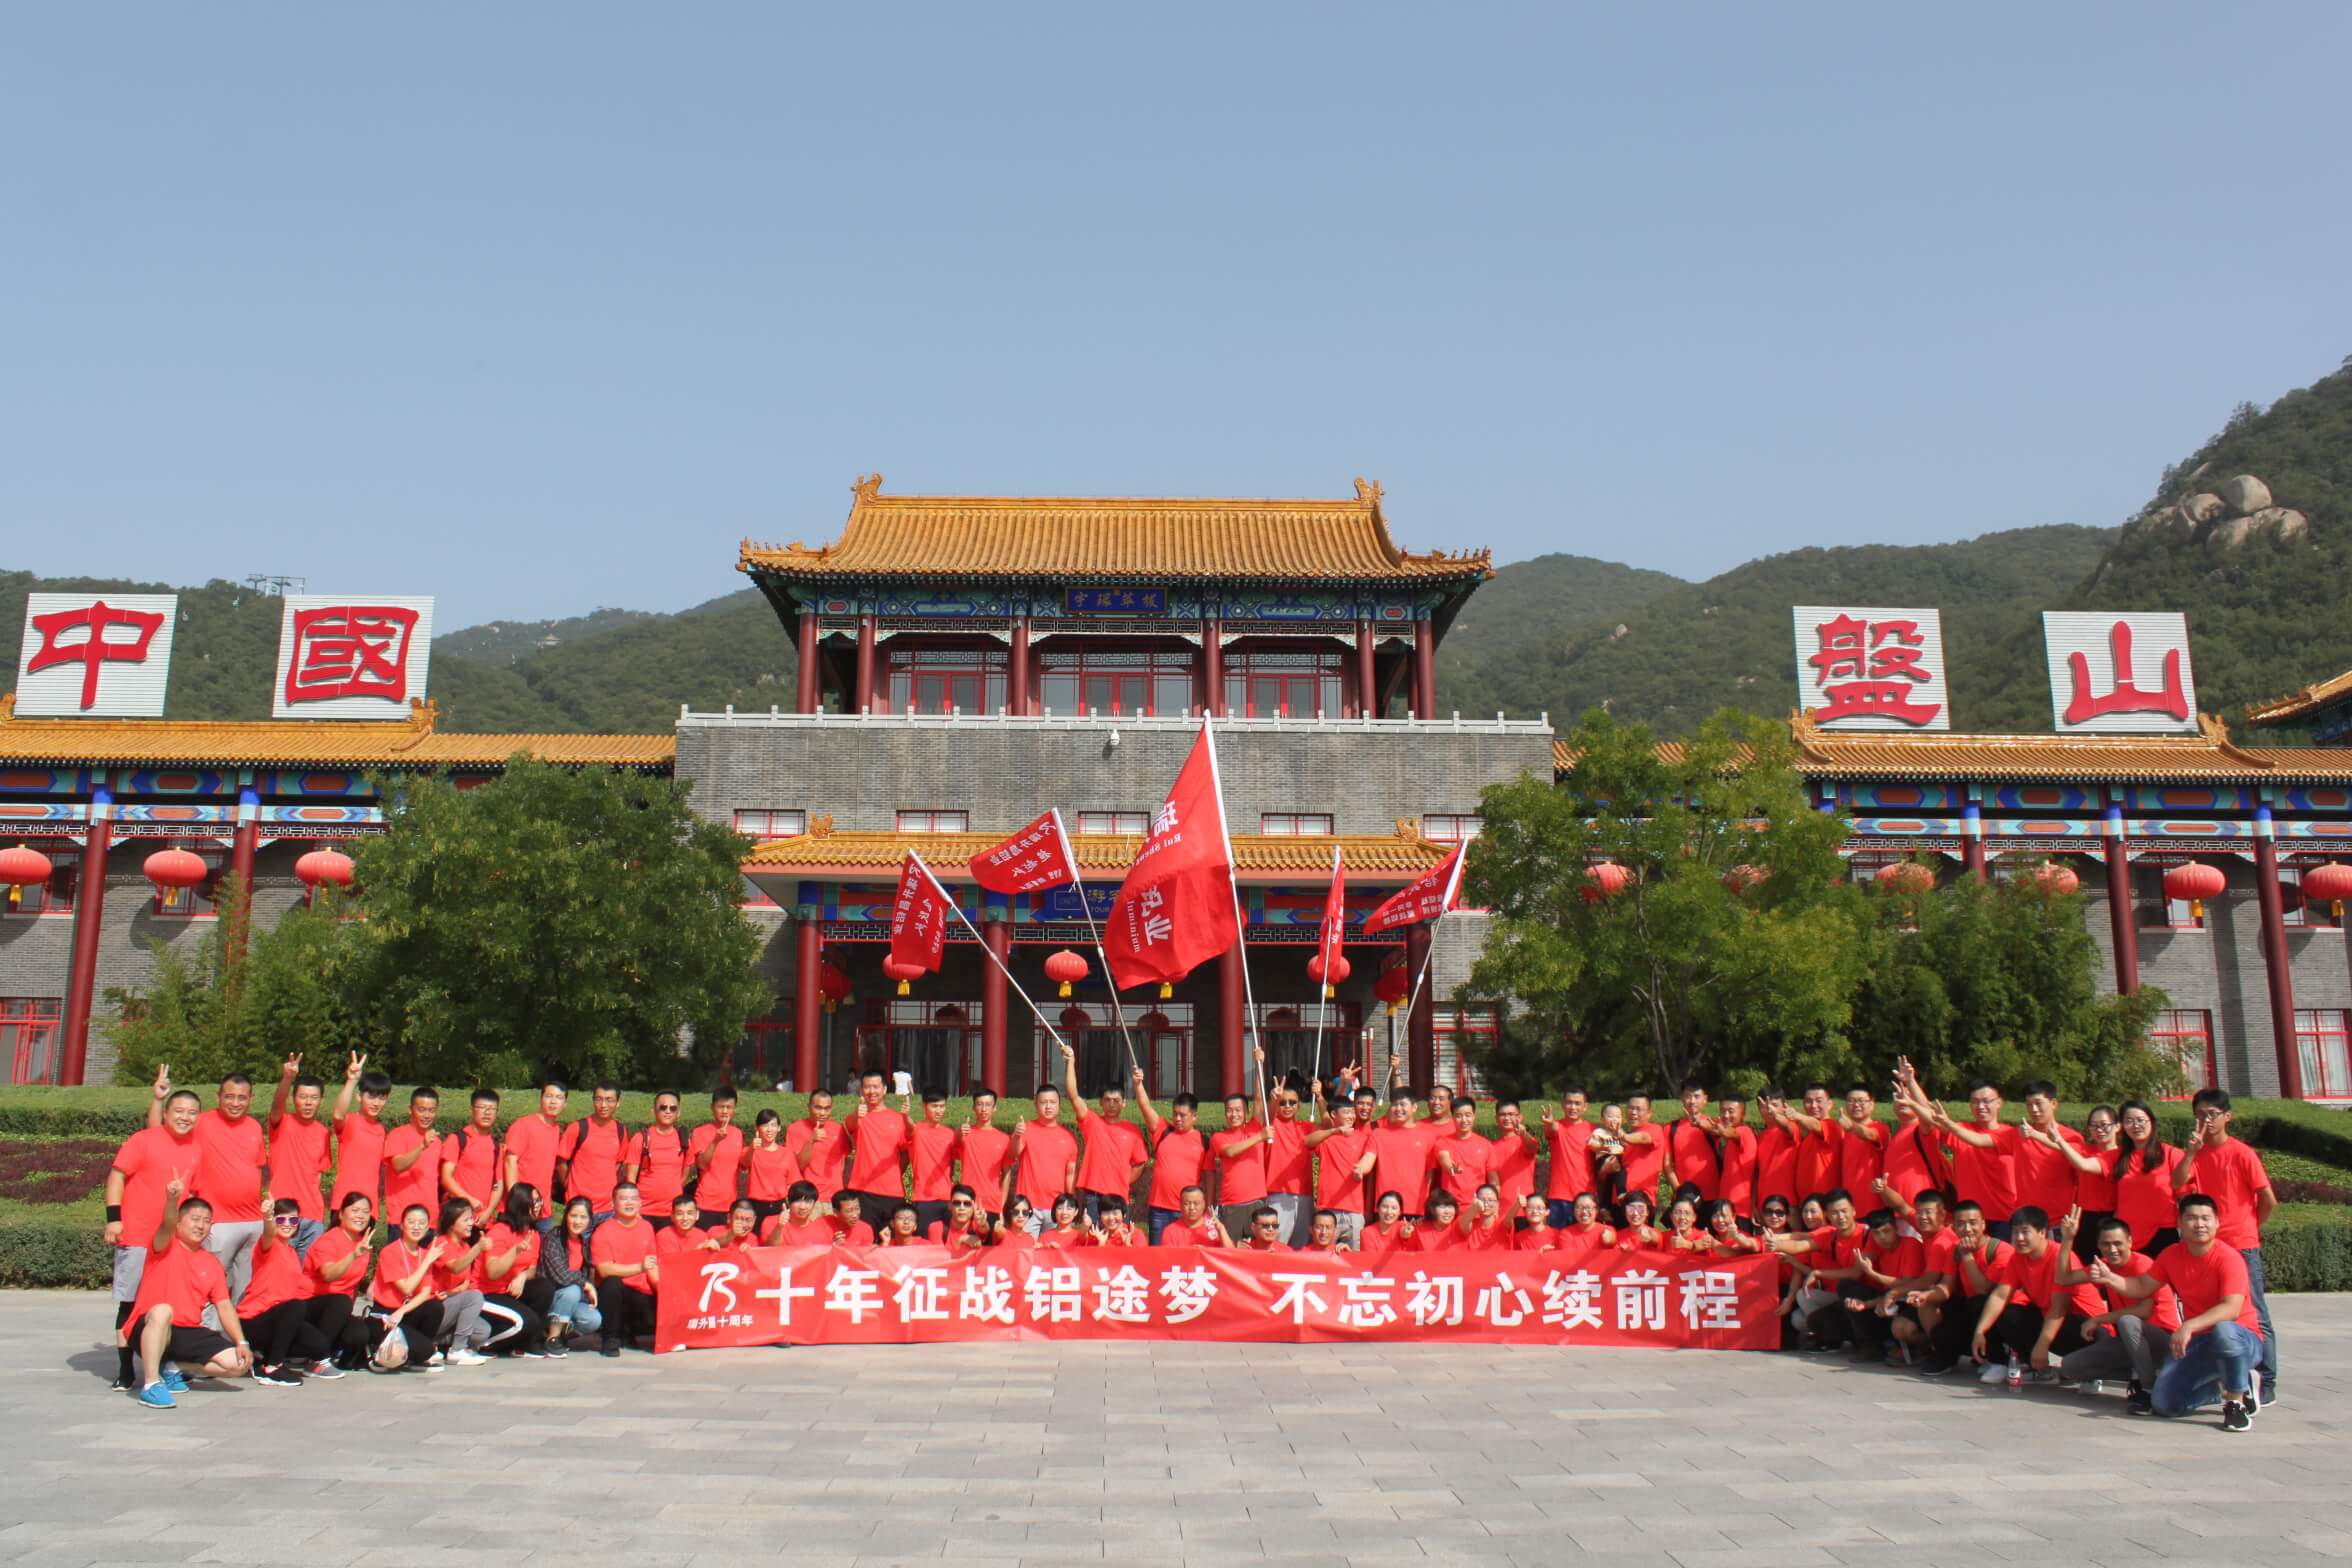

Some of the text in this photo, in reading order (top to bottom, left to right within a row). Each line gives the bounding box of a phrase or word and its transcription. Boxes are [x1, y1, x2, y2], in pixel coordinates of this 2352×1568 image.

[755, 1263, 1742, 1330] 十年征战铝途梦 不忘初心续前程
